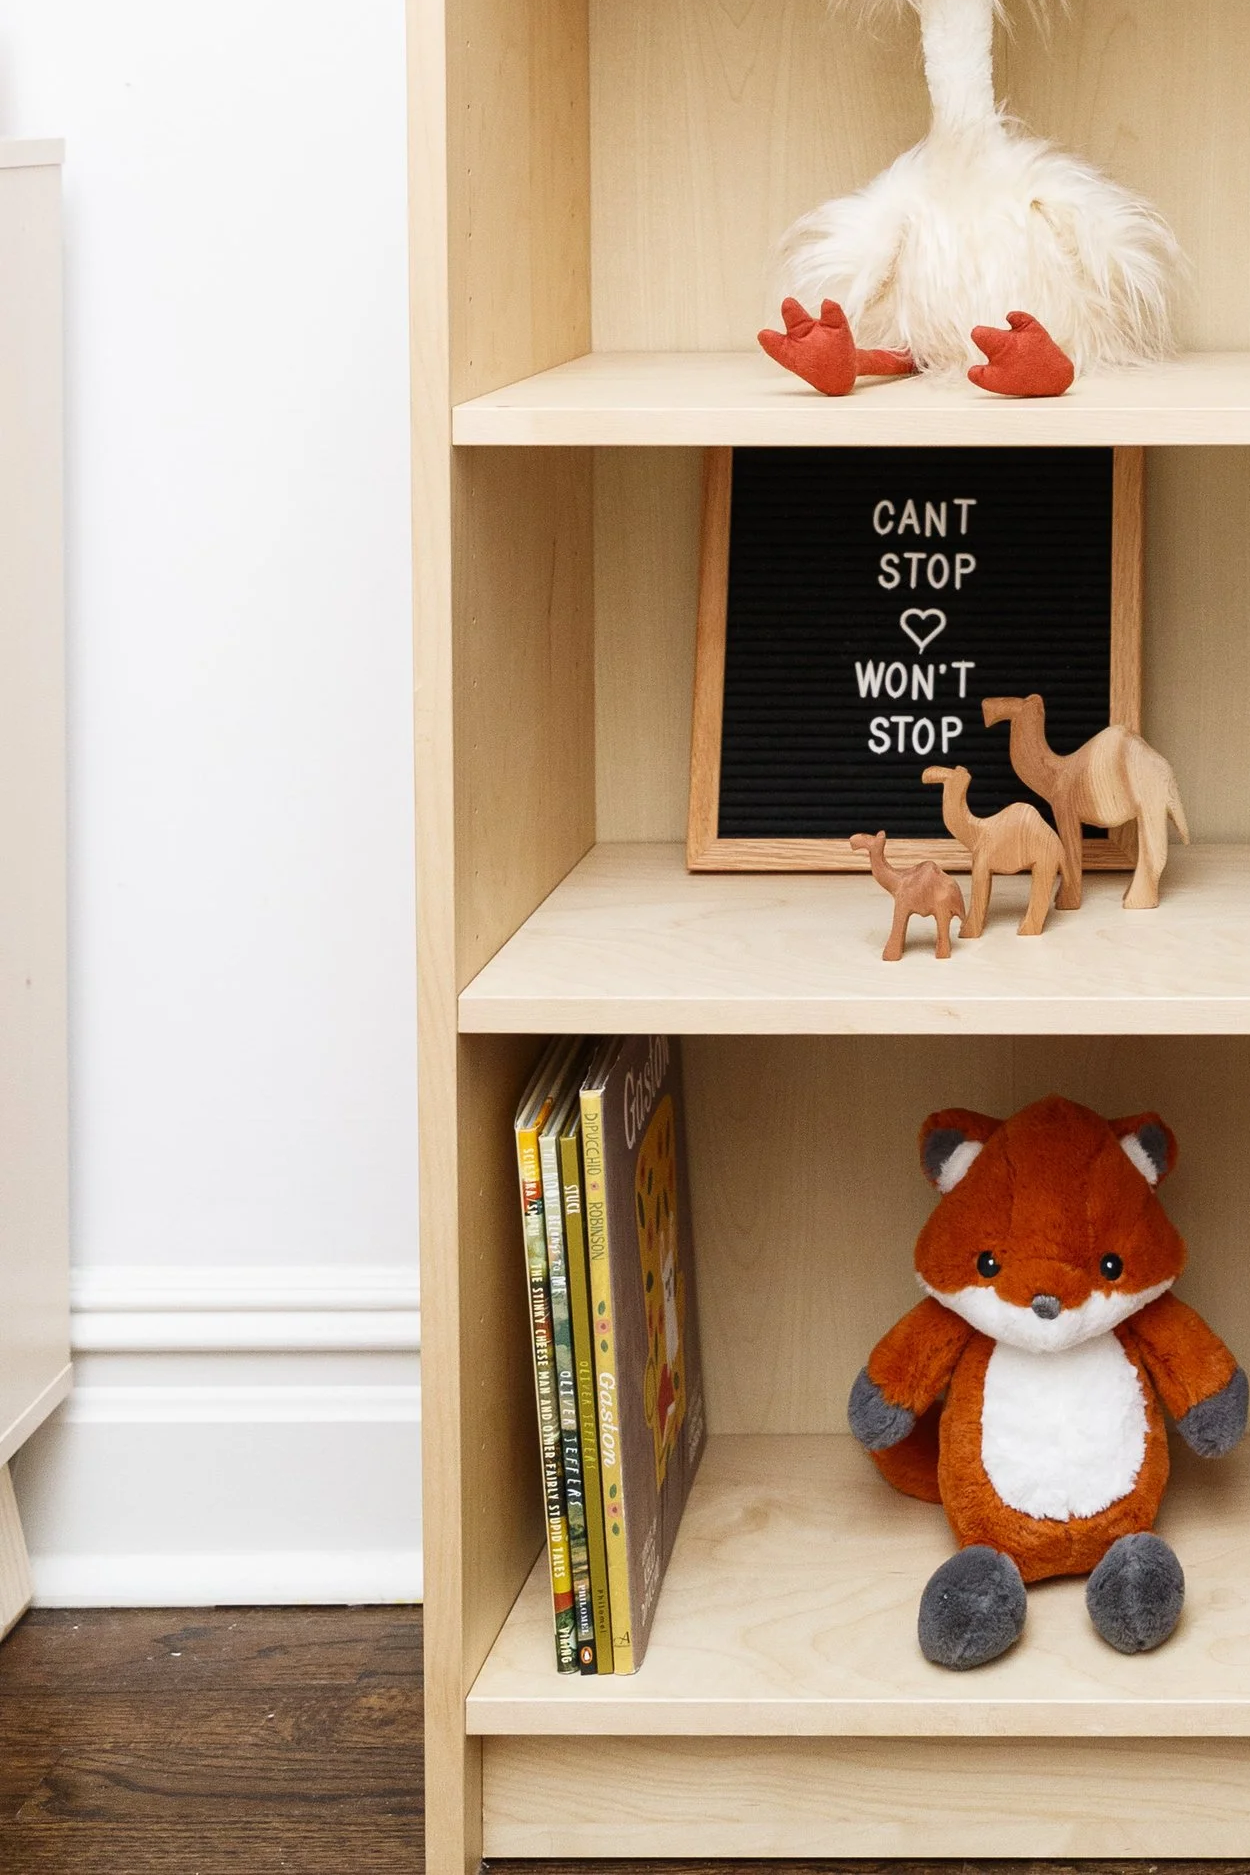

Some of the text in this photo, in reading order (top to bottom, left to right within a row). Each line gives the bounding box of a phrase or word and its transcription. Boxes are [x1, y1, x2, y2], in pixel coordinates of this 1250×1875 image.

[872, 499, 977, 537] CANT
[877, 553, 976, 589] STOP
[854, 660, 976, 701] WON'T
[868, 715, 963, 755] STOP
[564, 1184, 580, 1215] STUCK
[548, 1215, 561, 1254] BELONGS
[589, 1202, 604, 1261] ROBINSON
[551, 1275, 566, 1297] ME
[531, 1263, 566, 1579] THE STINKY CHEESE MAN AND OTHER FAIRLY STUPID TALES
[579, 1361, 596, 1470] OLIVER JEFFERS
[598, 1372, 619, 1467] Gaston
[560, 1371, 582, 1507] OLIVER JEFFERS
[578, 1585, 590, 1635] PHILOMEL
[597, 1589, 607, 1634] Philomel
[558, 1626, 572, 1663] VIKING
